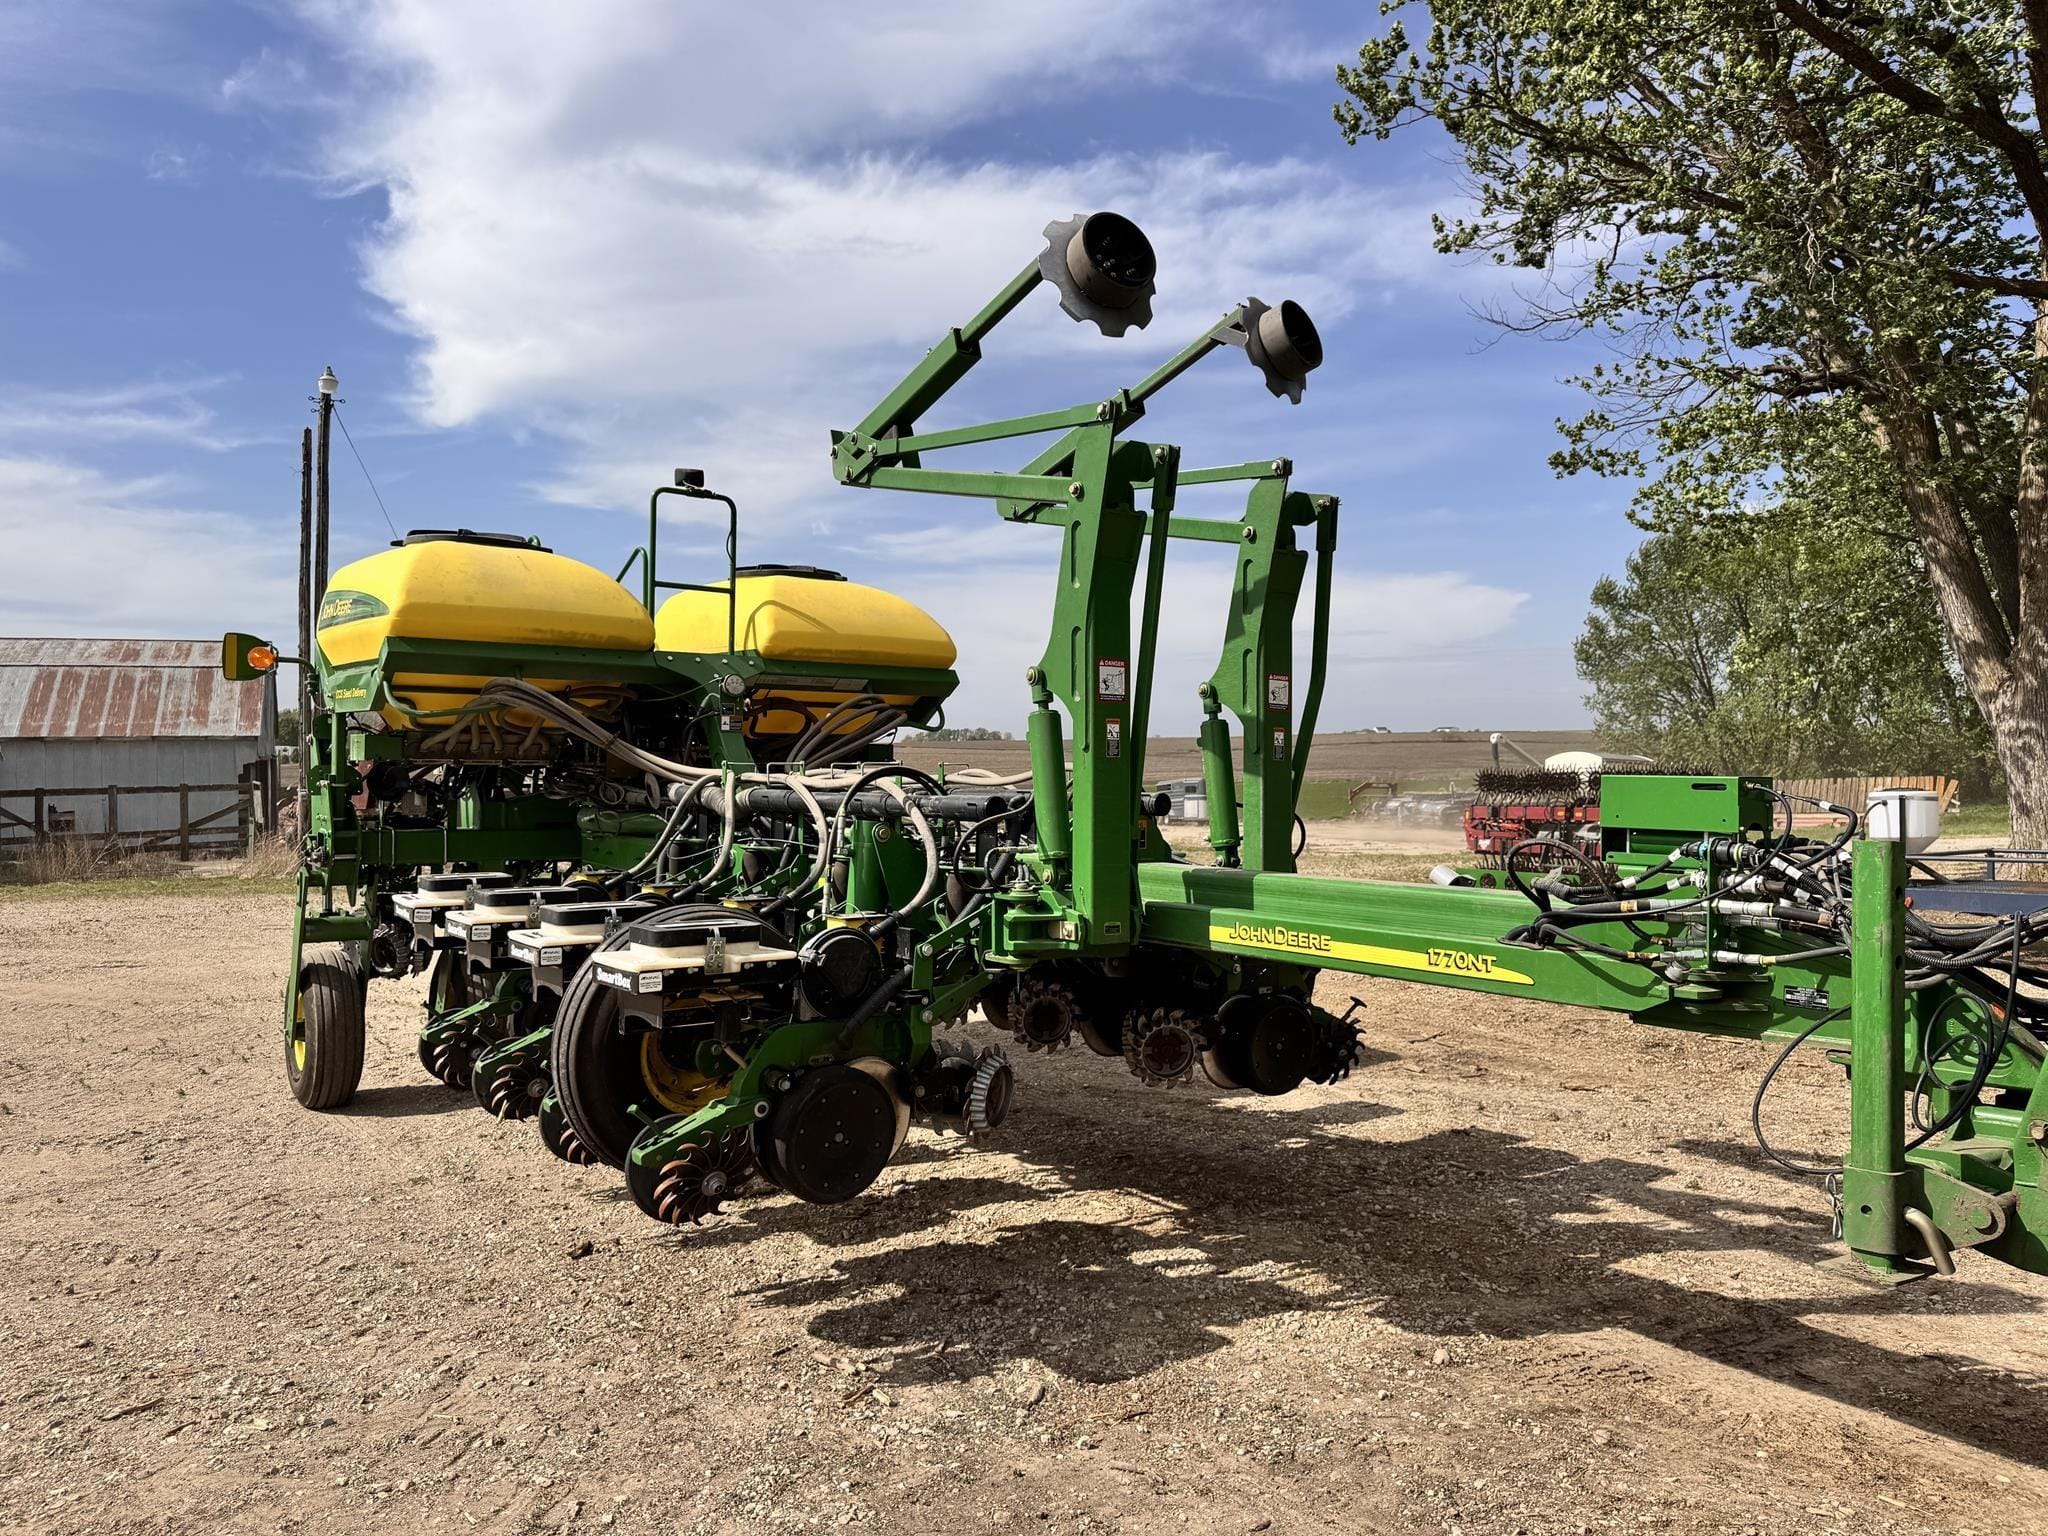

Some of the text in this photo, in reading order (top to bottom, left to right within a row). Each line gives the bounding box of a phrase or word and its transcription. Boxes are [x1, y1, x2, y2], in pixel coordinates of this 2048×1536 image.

[1230, 921, 1331, 951] JOHN DEERE
[1427, 947, 1497, 973] 1770NT
[596, 967, 631, 991] SmartBox
